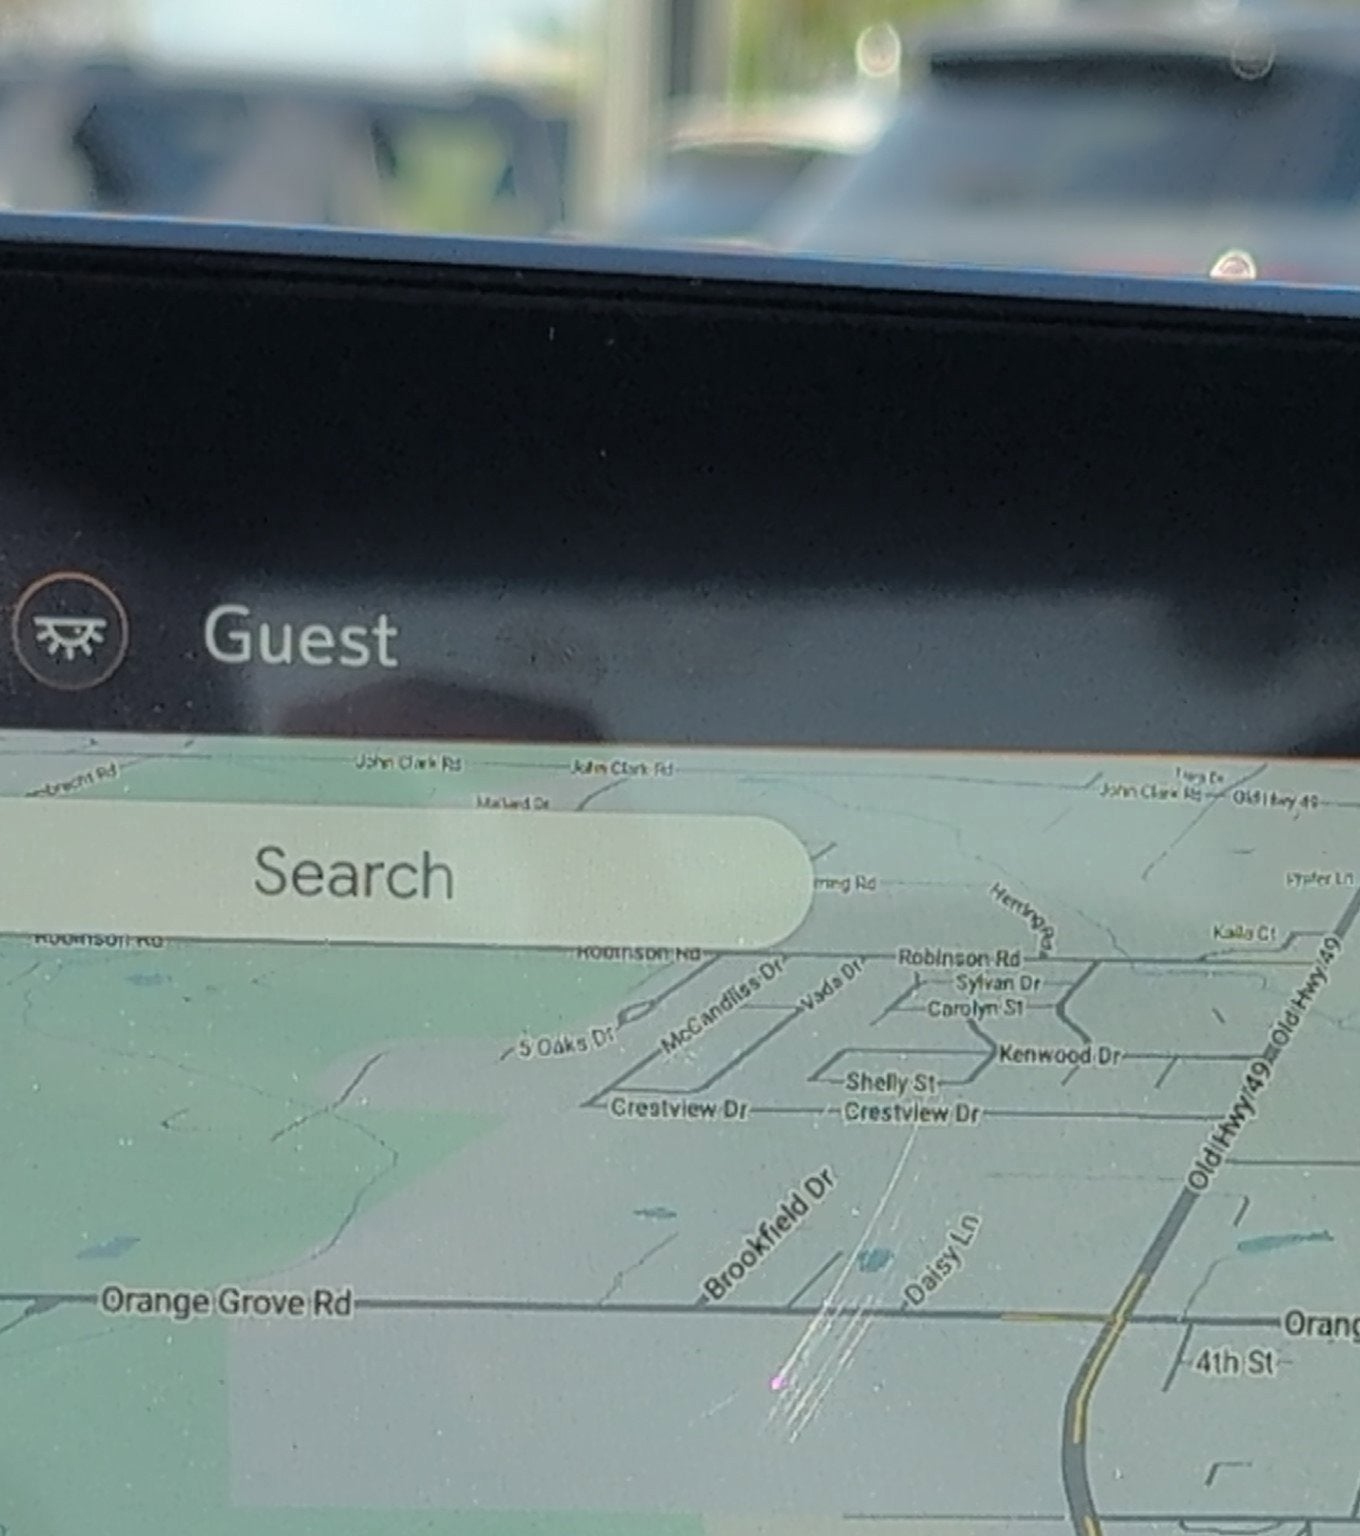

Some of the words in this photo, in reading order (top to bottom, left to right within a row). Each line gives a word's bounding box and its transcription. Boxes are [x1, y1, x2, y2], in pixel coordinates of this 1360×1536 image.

[203, 602, 398, 667] Guest
[254, 845, 454, 900] Search
[815, 879, 851, 894] rring
[898, 950, 989, 968] Robinson
[995, 951, 1020, 968] Rd
[800, 976, 844, 1011] Vada
[842, 959, 863, 982] Dr
[955, 975, 1013, 995] Sylvan
[1020, 976, 1040, 991] Dr
[1271, 1010, 1300, 1048] Old
[1291, 964, 1328, 1010] Hwy
[1317, 937, 1341, 964] 49
[660, 981, 761, 1054] McCandliss
[758, 958, 784, 984] Dr
[928, 1001, 998, 1021] Carolyn
[1003, 1001, 1024, 1016] St
[538, 1036, 588, 1056] Oaks
[592, 1027, 614, 1047] Dr
[1000, 1045, 1092, 1064] Kenwood
[1098, 1047, 1121, 1065] Dr
[846, 1073, 908, 1094] Shelly
[914, 1074, 935, 1091] St
[610, 1101, 715, 1119] Crestview
[723, 1102, 749, 1119] Dr
[844, 1103, 948, 1122] Crestview
[956, 1105, 980, 1122] Dr
[1188, 1146, 1222, 1190] Old
[1212, 1096, 1256, 1147] Hwy
[1246, 1061, 1271, 1095] 49
[703, 1195, 810, 1301] Brookfield
[804, 1168, 835, 1200] Dr
[903, 1246, 962, 1306] Daisy
[949, 1213, 981, 1250] Ln
[102, 1286, 210, 1320] Orange
[218, 1287, 305, 1316] Grove
[314, 1288, 352, 1316] Rd
[1195, 1350, 1240, 1373] 4th
[1248, 1350, 1274, 1374] St
